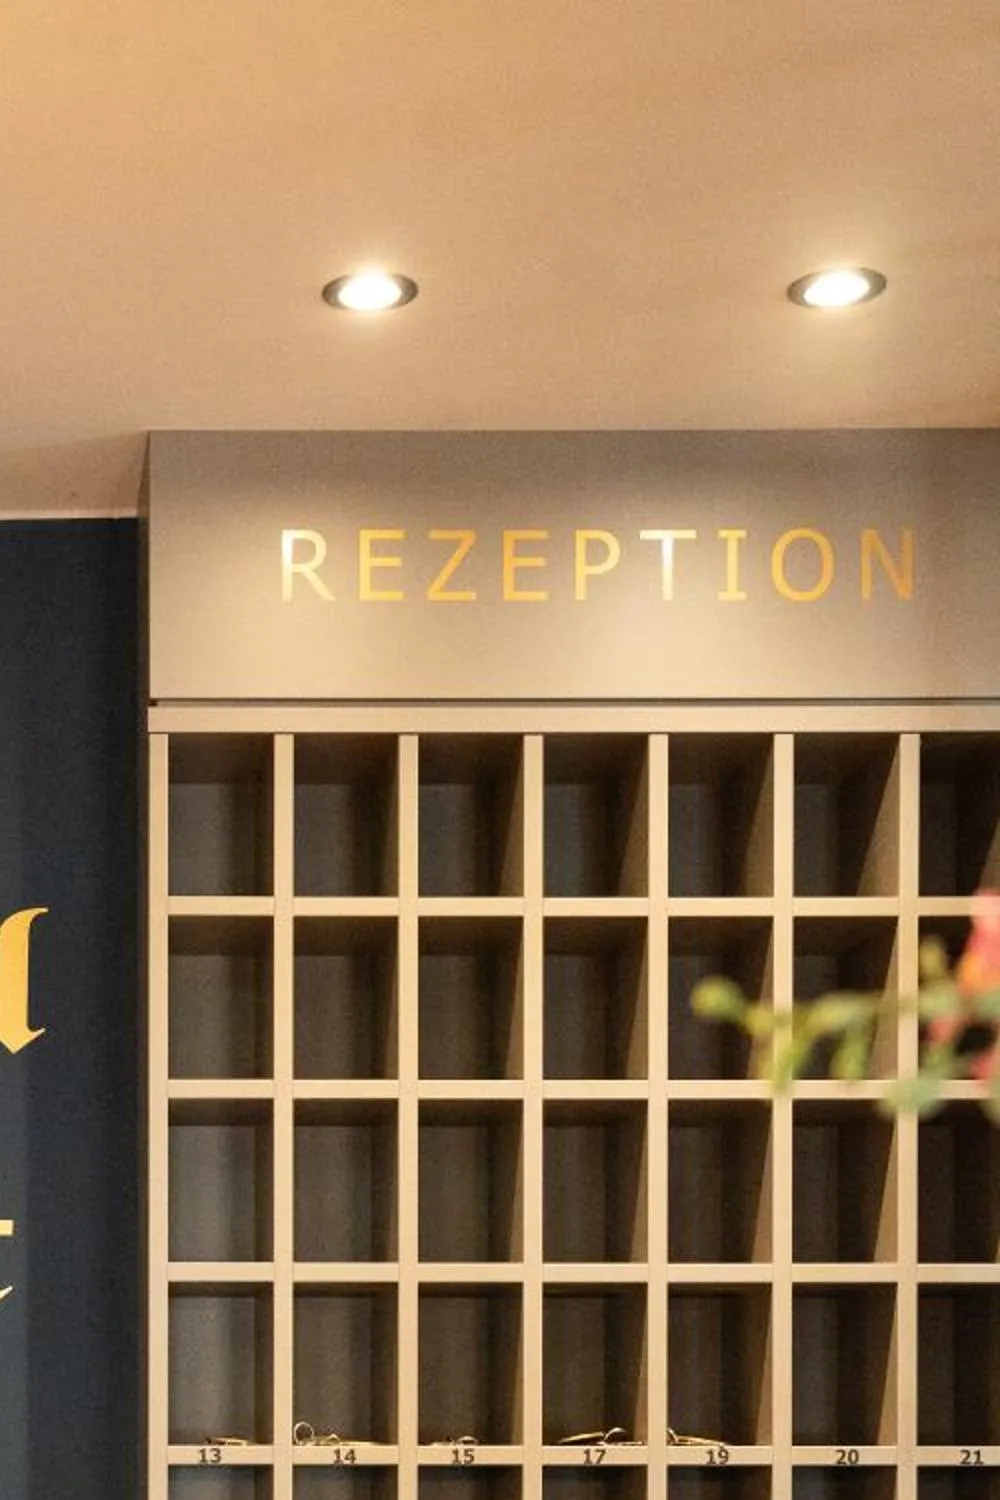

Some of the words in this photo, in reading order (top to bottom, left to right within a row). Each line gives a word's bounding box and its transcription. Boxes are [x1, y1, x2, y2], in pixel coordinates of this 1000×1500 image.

[280, 528, 915, 601] REZEPTION
[199, 1448, 222, 1465] 13
[333, 1448, 357, 1465] 14
[451, 1448, 475, 1465] 15
[583, 1448, 606, 1465] 17
[706, 1448, 729, 1465] 19
[836, 1449, 860, 1466] 20
[961, 1449, 984, 1466] 21
